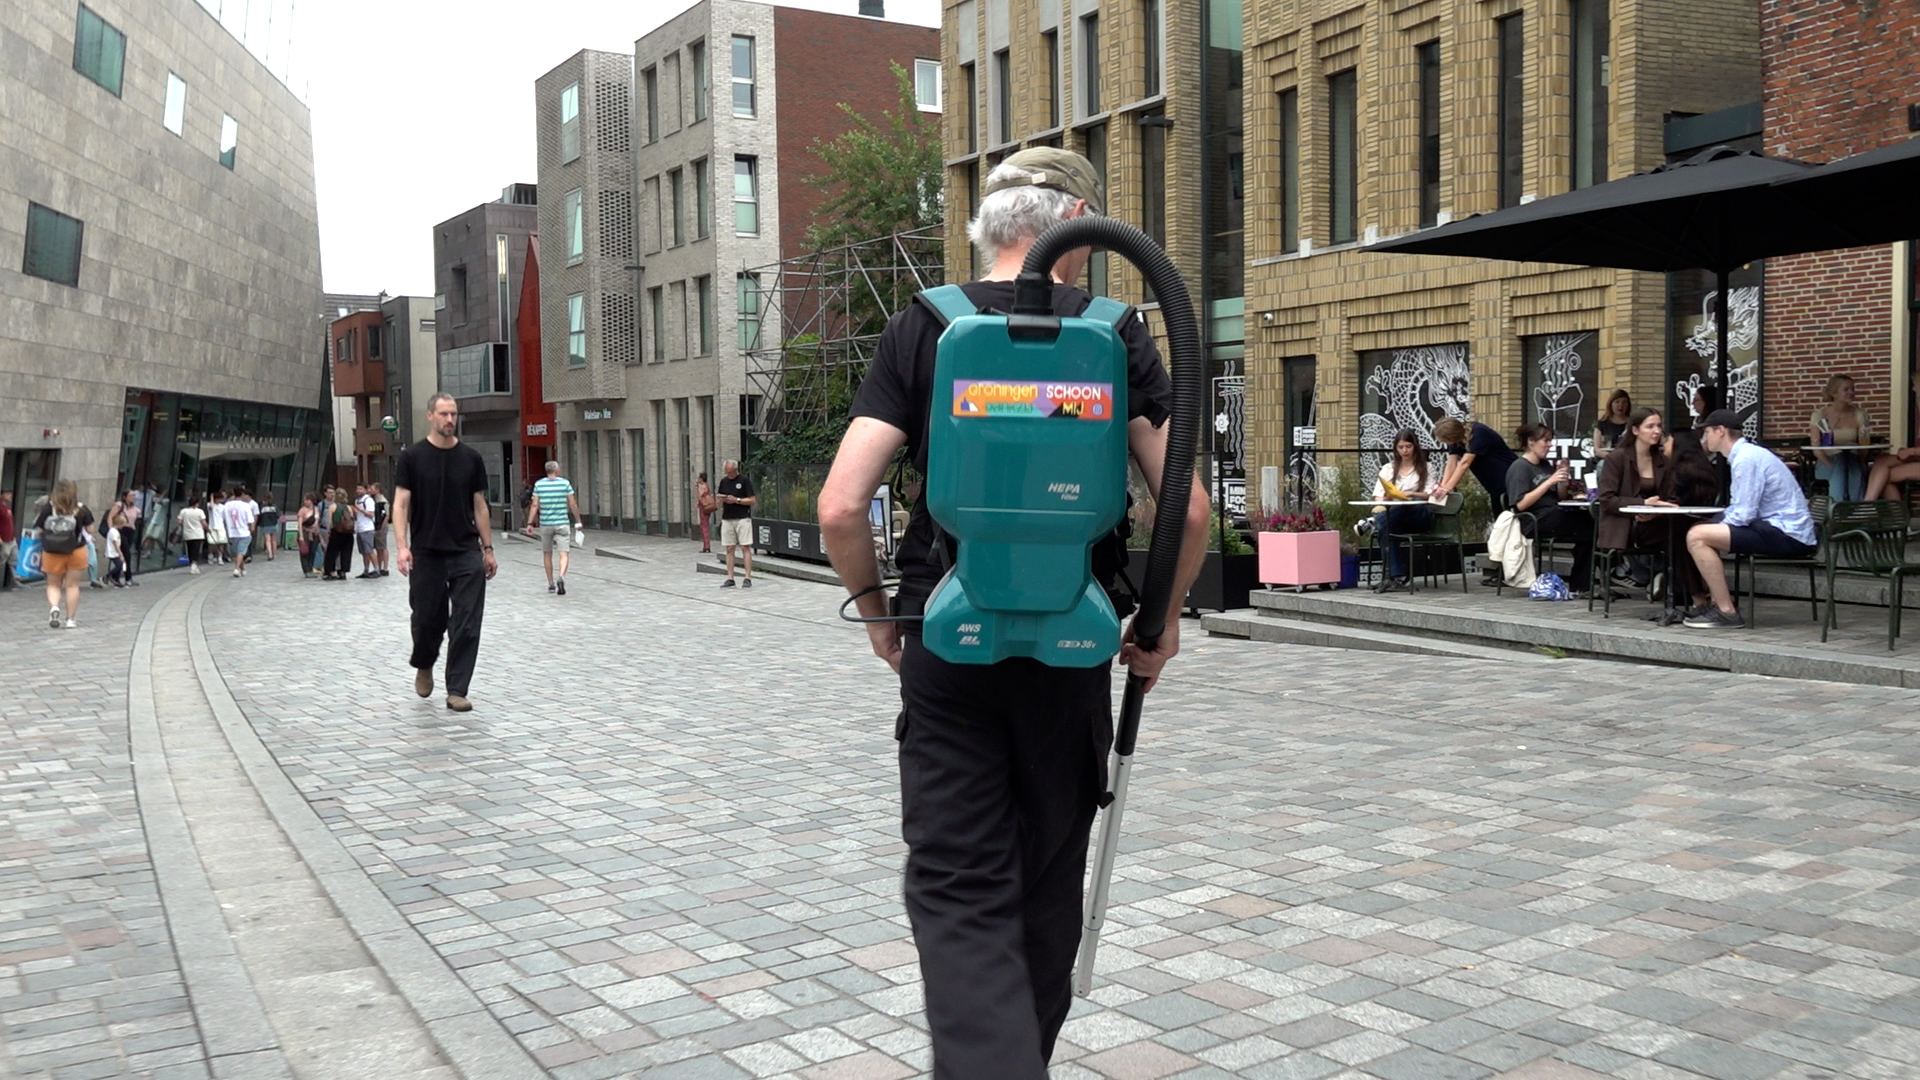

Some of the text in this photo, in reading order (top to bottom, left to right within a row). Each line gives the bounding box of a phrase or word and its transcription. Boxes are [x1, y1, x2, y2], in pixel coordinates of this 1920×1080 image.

[1046, 385, 1102, 400] SCHOON
[1062, 401, 1085, 415] MIJ
[1546, 438, 1595, 459] ET'S
[1047, 482, 1081, 494] HEPA
[956, 623, 982, 633] AWS
